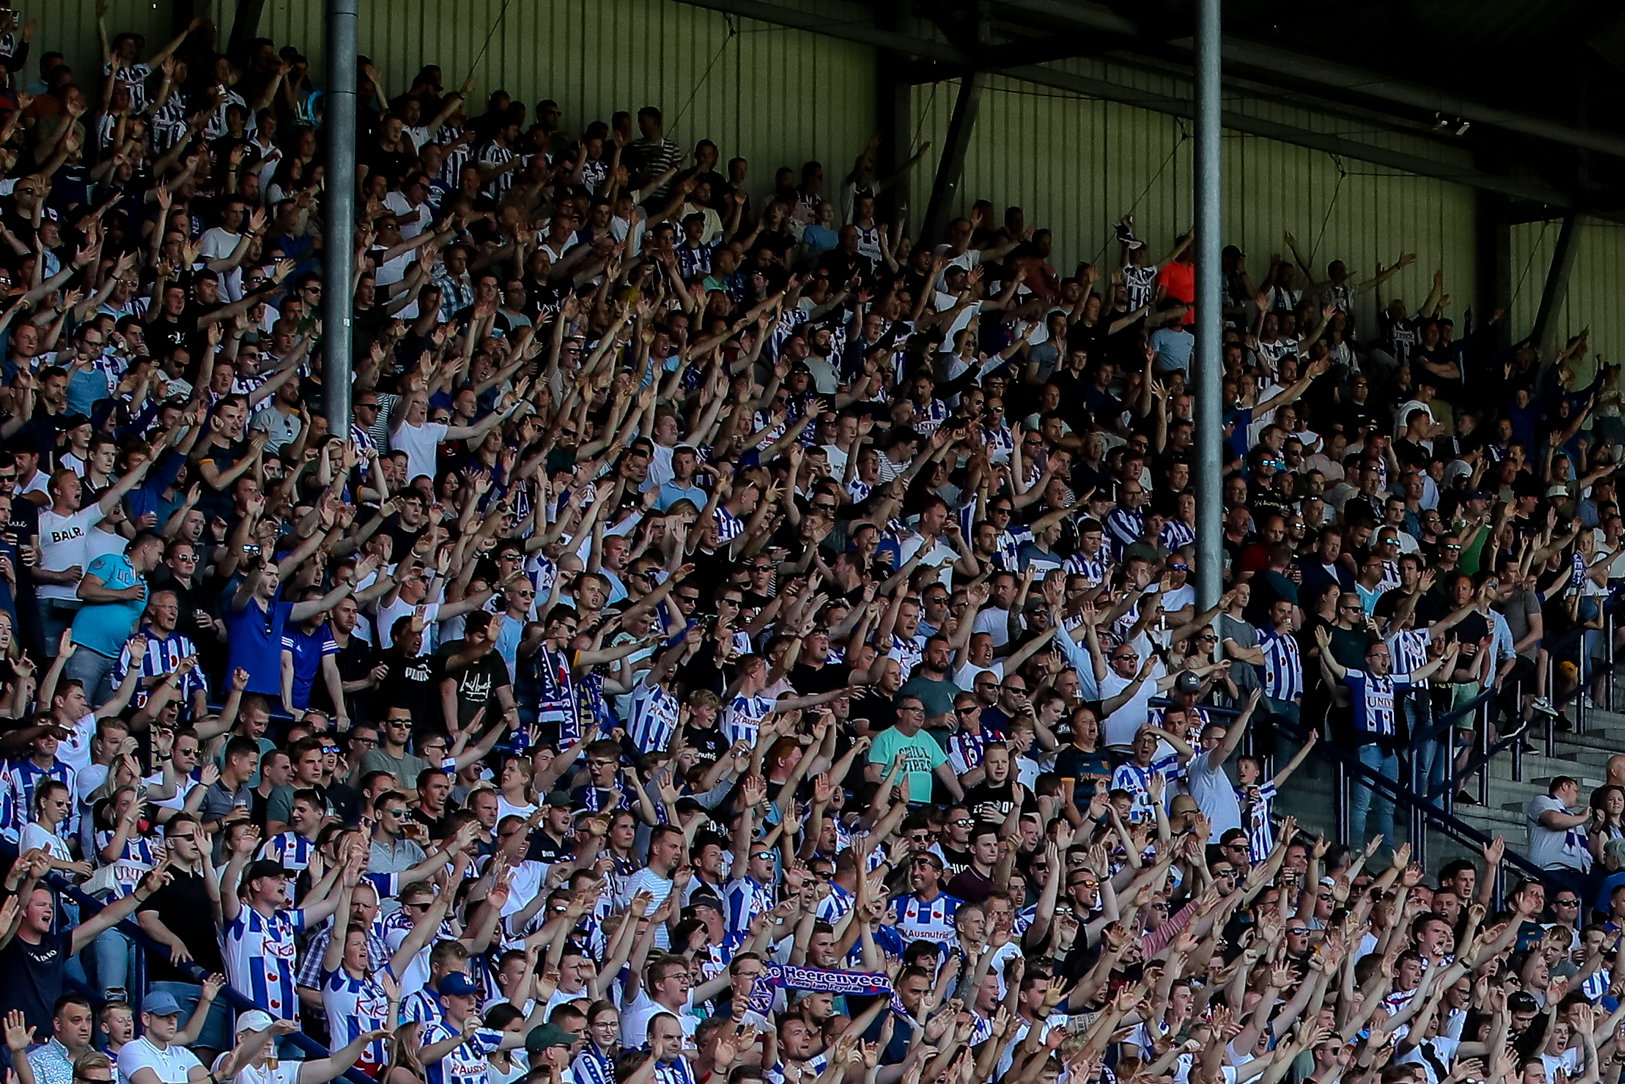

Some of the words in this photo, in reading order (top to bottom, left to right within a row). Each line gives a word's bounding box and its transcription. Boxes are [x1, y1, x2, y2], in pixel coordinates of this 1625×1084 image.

[51, 526, 84, 544] BALR.
[560, 686, 576, 736] ARMY
[783, 965, 890, 988] Heerenveen
